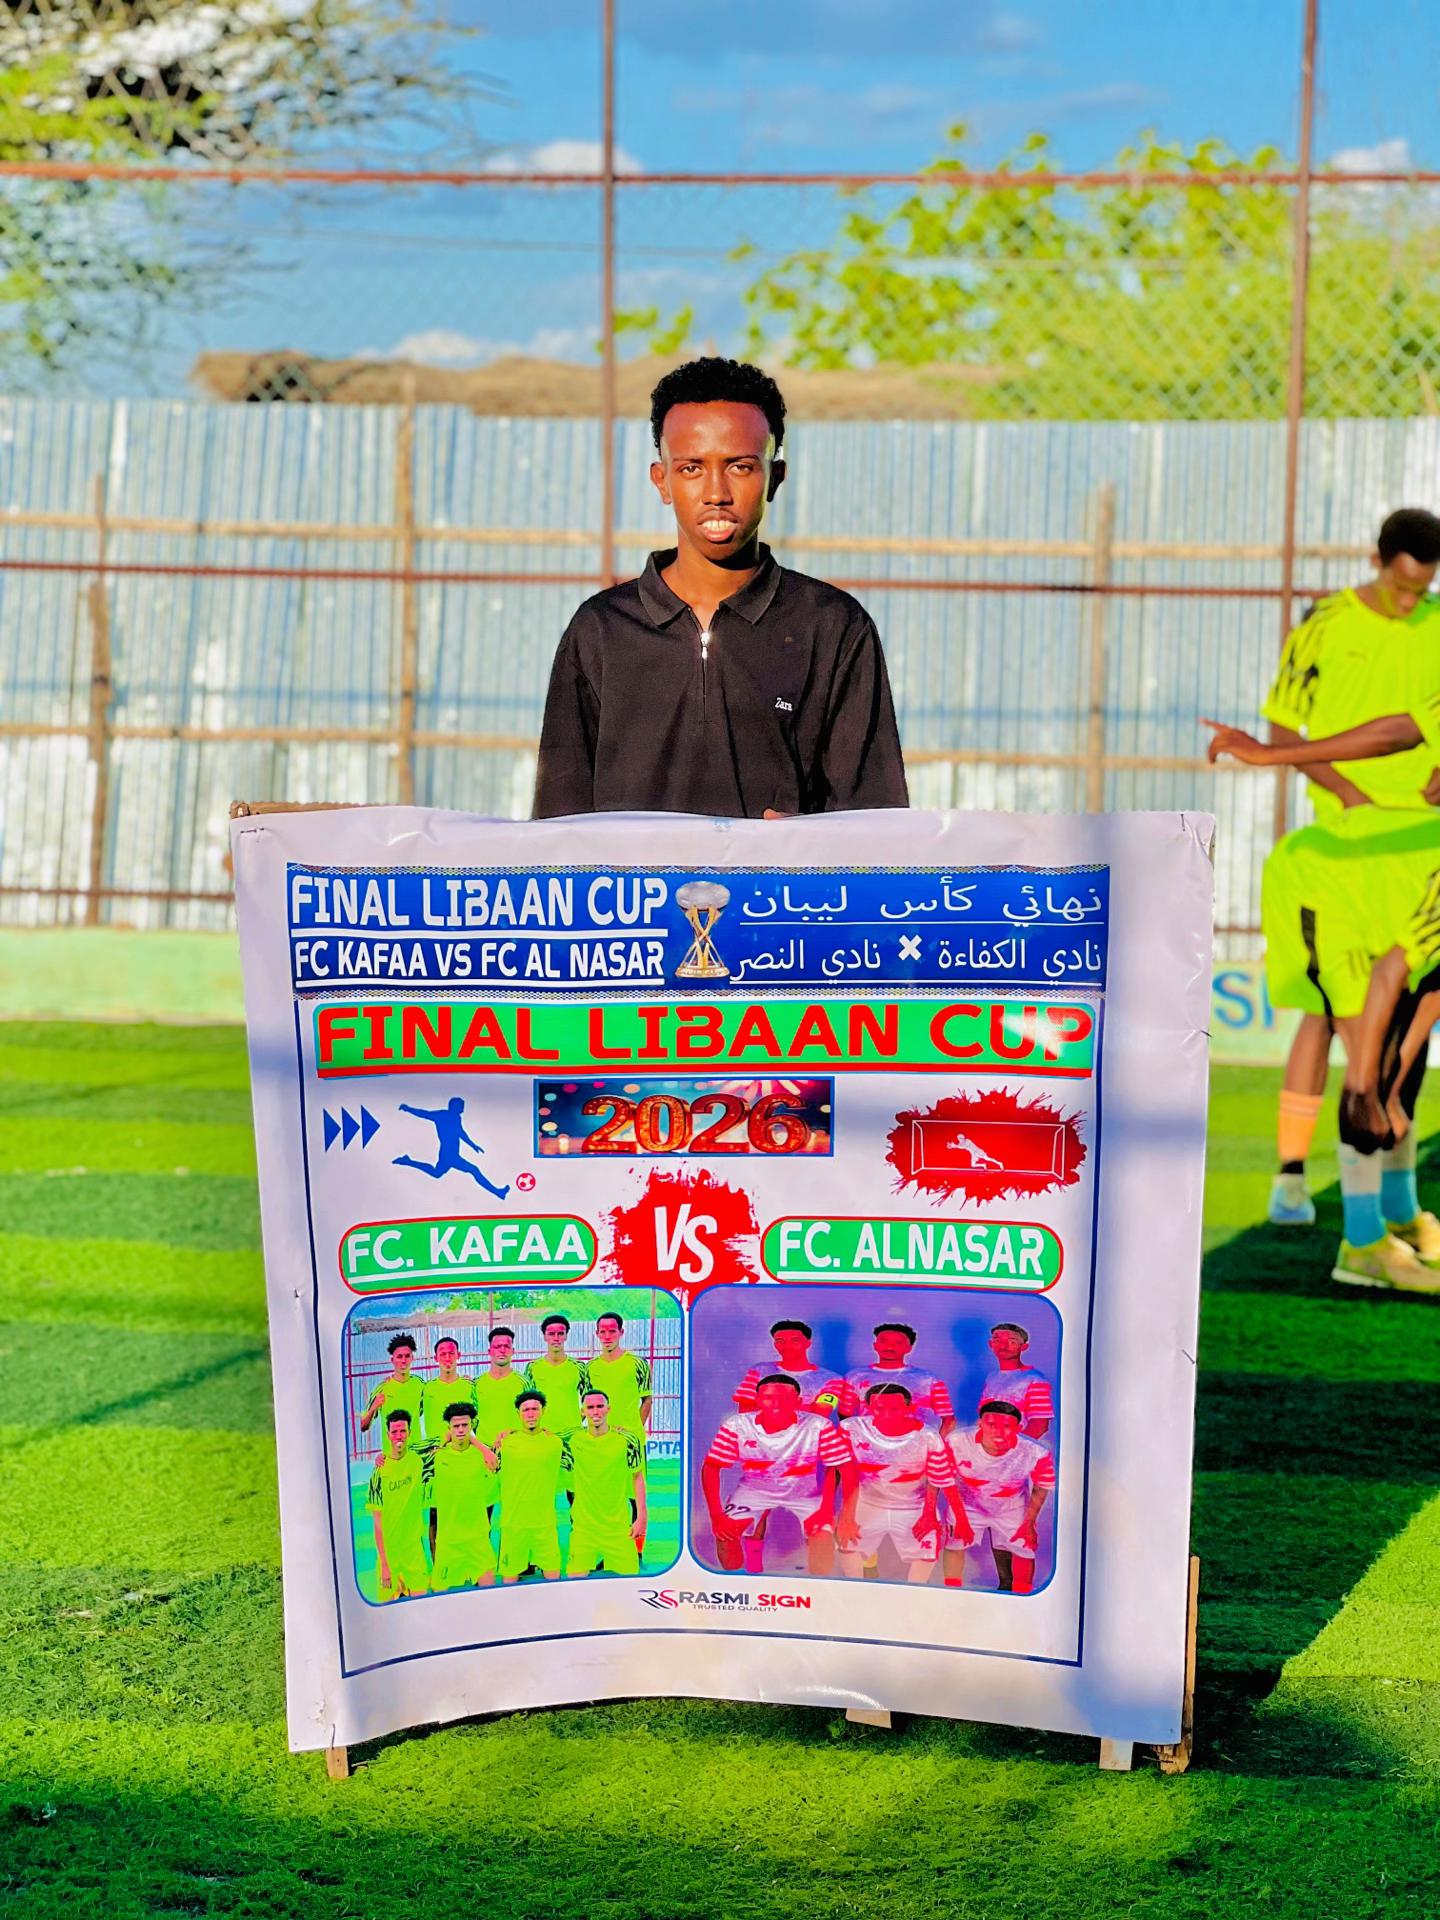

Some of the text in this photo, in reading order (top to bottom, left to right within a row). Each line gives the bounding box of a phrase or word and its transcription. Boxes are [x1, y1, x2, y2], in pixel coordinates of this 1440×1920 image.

[291, 875, 668, 927] FINAL LIBAAN CUP
[742, 875, 1102, 927] نهائي كأس ليبان
[295, 940, 664, 978] FC KAFAA VS FC AL NASAR
[730, 939, 804, 981] النصر
[938, 939, 1026, 970] الكفاءة
[318, 1004, 1092, 1062] FINAL LIBAAN CUP
[581, 1093, 811, 1154] 2026
[348, 1224, 588, 1273] FC. KAFAA
[654, 1203, 718, 1283] VS
[779, 1222, 1045, 1276] FC. ALNASAR
[679, 1591, 749, 1605] RASMI
[757, 1594, 811, 1609] SIGN
[737, 1605, 778, 1613] QUALITY
